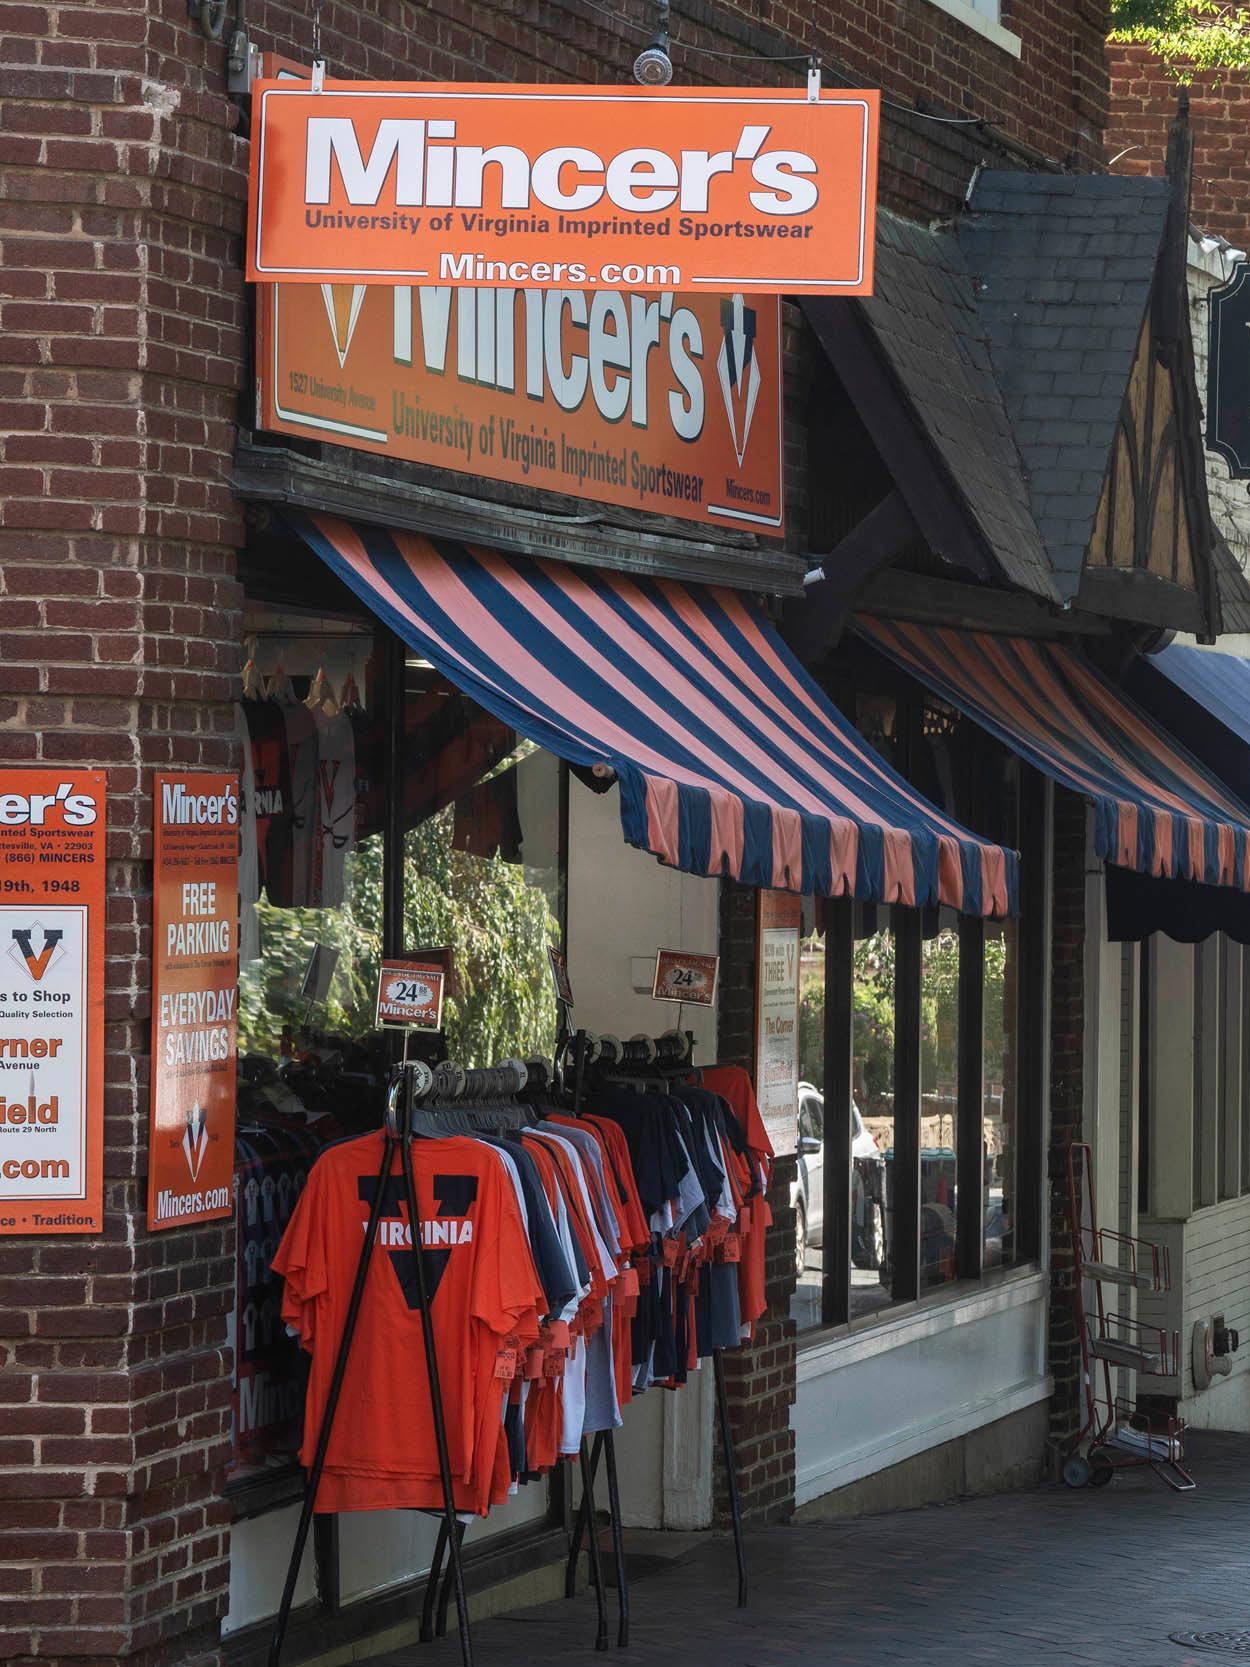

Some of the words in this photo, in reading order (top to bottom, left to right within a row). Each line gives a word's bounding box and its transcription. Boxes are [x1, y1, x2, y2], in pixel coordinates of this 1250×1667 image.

[304, 116, 820, 216] Mincer's
[305, 210, 421, 236] University
[430, 212, 453, 232] of
[461, 213, 551, 237] Virginia
[558, 216, 670, 239] Imprinted
[678, 218, 813, 241] Sportswear
[439, 252, 681, 286] Mincers.com
[392, 391, 472, 459] University
[479, 415, 496, 455] of
[500, 426, 556, 475] Virginia
[561, 433, 627, 490] Imprinted
[630, 451, 704, 505] Sportswear
[162, 783, 237, 826] Mincer's
[30, 828, 95, 839] Sportswear
[40, 842, 54, 850] VA
[64, 842, 93, 850] 22903
[5, 853, 35, 864] (866)
[39, 853, 95, 863] MINCERS
[42, 880, 80, 893] 1948
[182, 882, 216, 916] FREE
[167, 920, 230, 957] PARKING
[673, 969, 692, 986] 24
[12, 991, 28, 1002] to
[33, 990, 71, 1004] Shop
[395, 982, 417, 1001] 24
[32, 1010, 73, 1019] Selection
[160, 988, 235, 1028] EVERYDAY
[380, 1002, 437, 1019] Mincer's
[165, 1027, 229, 1067] SAVINGS
[157, 1186, 229, 1220] Mincers.com
[32, 1214, 93, 1226] Tradition
